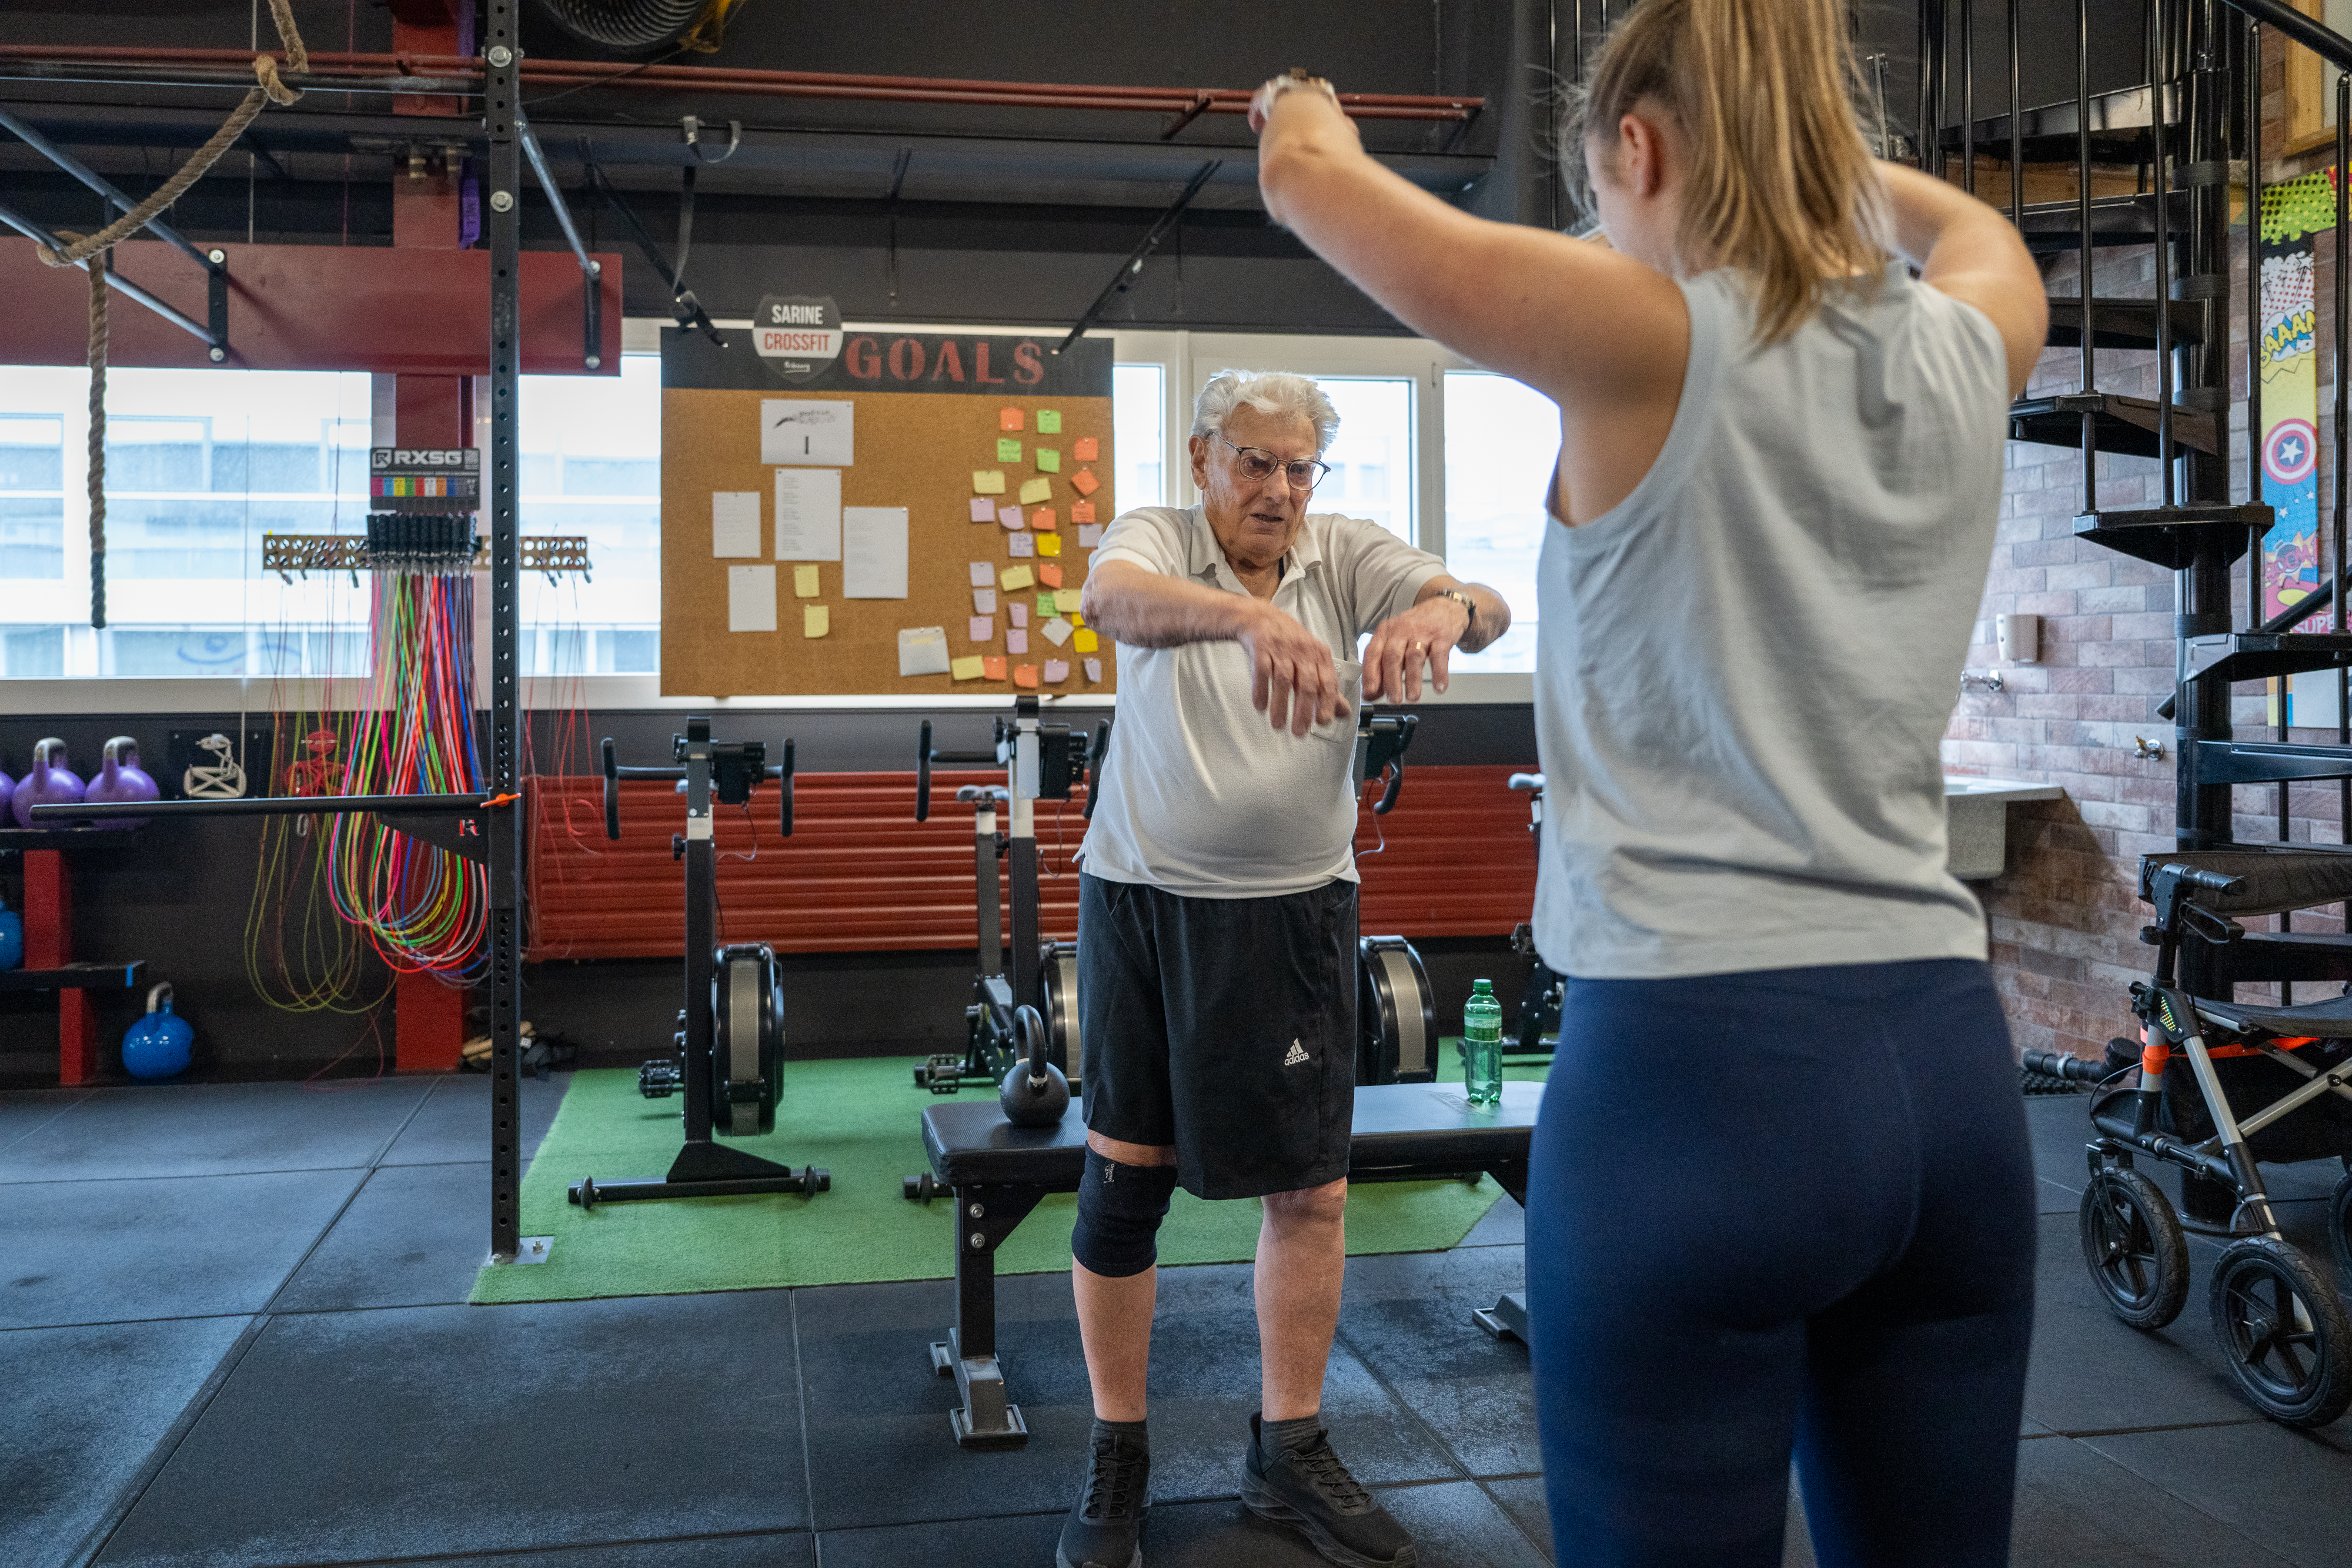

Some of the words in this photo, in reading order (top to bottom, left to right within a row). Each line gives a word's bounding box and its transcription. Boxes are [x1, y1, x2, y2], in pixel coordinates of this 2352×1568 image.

[771, 304, 824, 325] SARINE
[764, 333, 830, 351] CROSSFIT
[846, 335, 1045, 385] GOALS
[394, 450, 462, 465] RXSG
[1284, 1052, 1309, 1066] adidas
